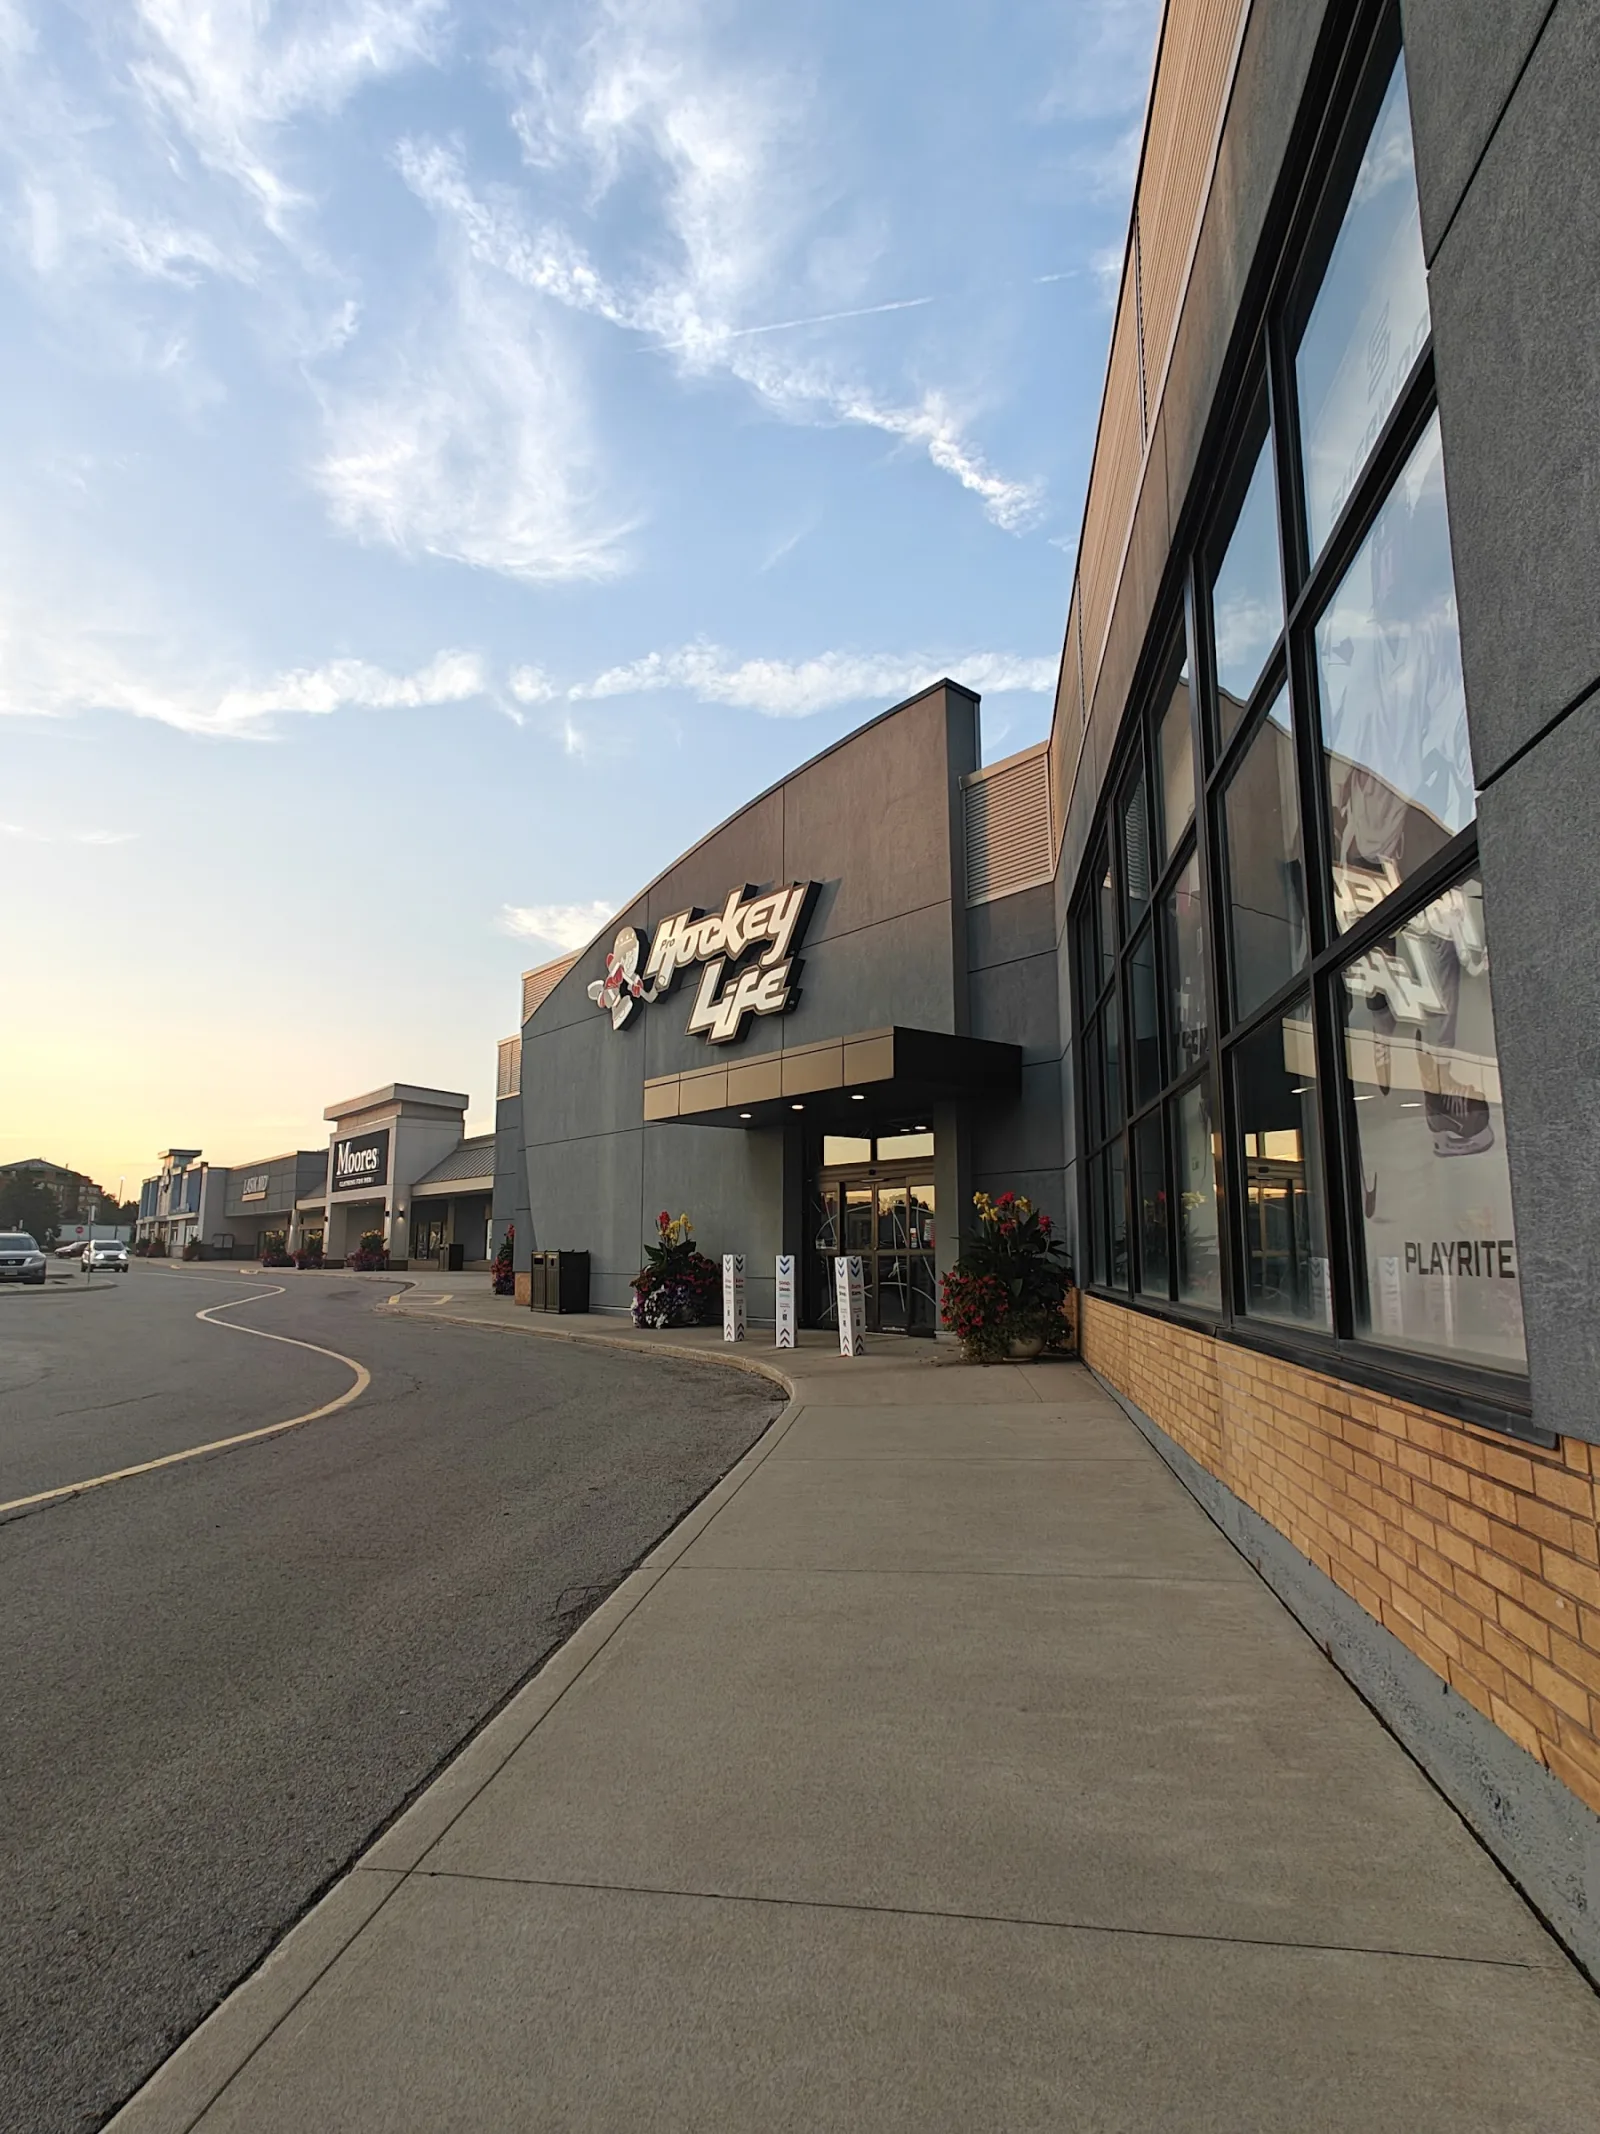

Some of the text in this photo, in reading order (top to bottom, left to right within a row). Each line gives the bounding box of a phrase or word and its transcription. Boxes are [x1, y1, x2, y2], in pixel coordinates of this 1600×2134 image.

[646, 886, 805, 988] Hockey
[659, 937, 676, 951] Pro
[687, 963, 787, 1041] Life
[336, 1141, 378, 1175] Moores
[1404, 1239, 1516, 1279] PLAYRITE
